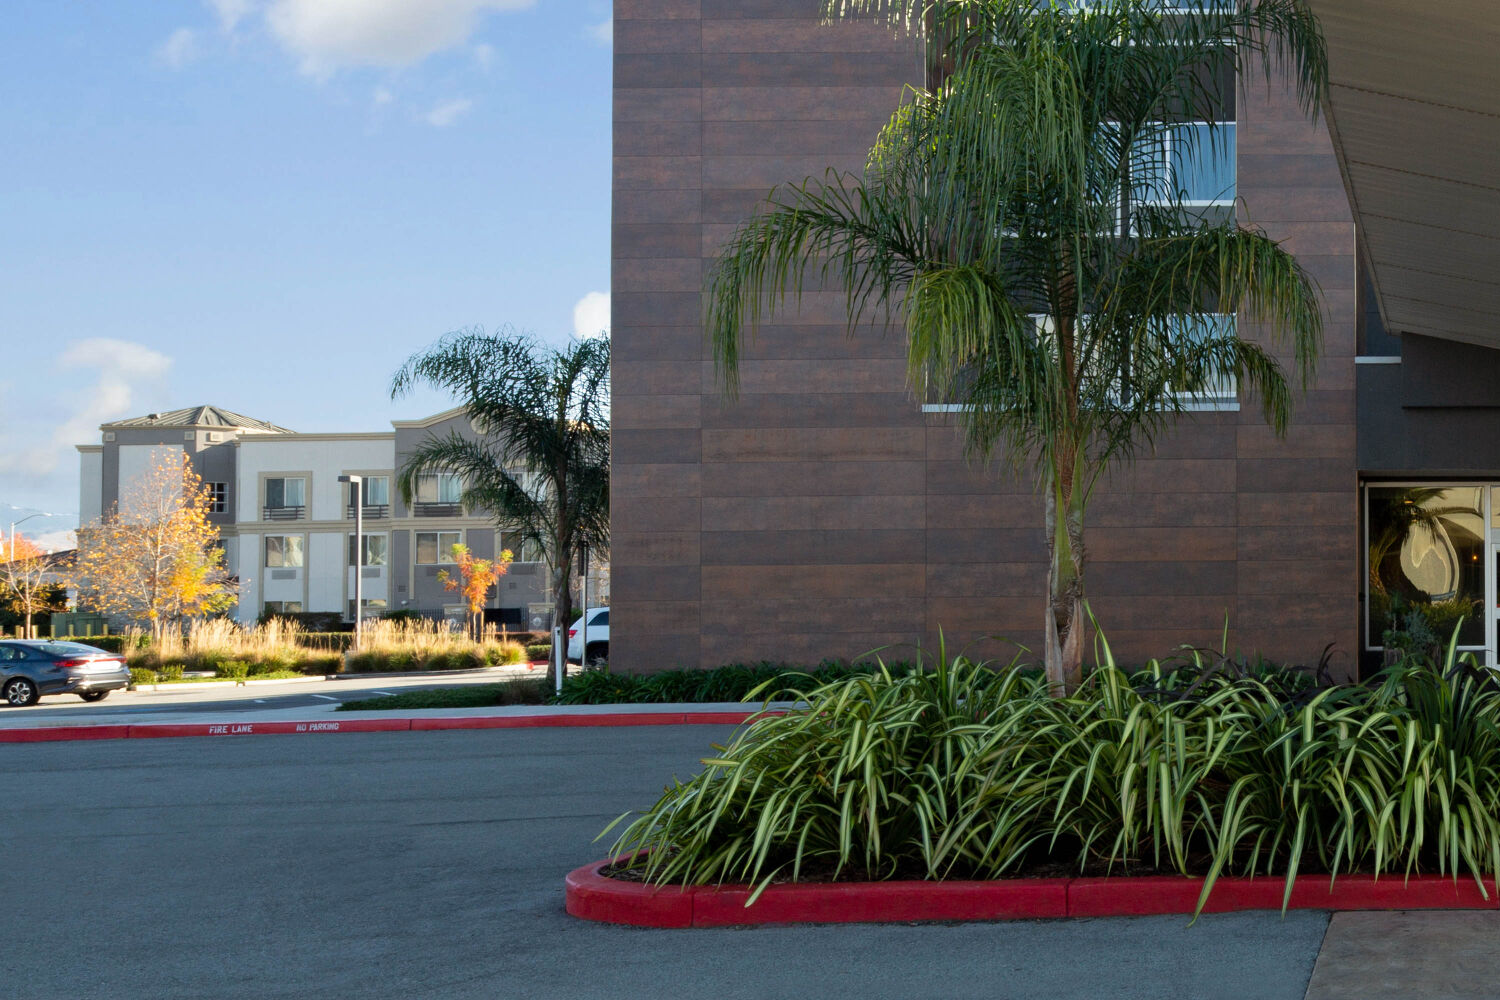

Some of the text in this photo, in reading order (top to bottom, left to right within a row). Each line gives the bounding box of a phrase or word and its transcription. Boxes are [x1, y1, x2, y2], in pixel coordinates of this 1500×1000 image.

[209, 724, 253, 734] FIRE LANE
[296, 722, 339, 732] NO PARKING
